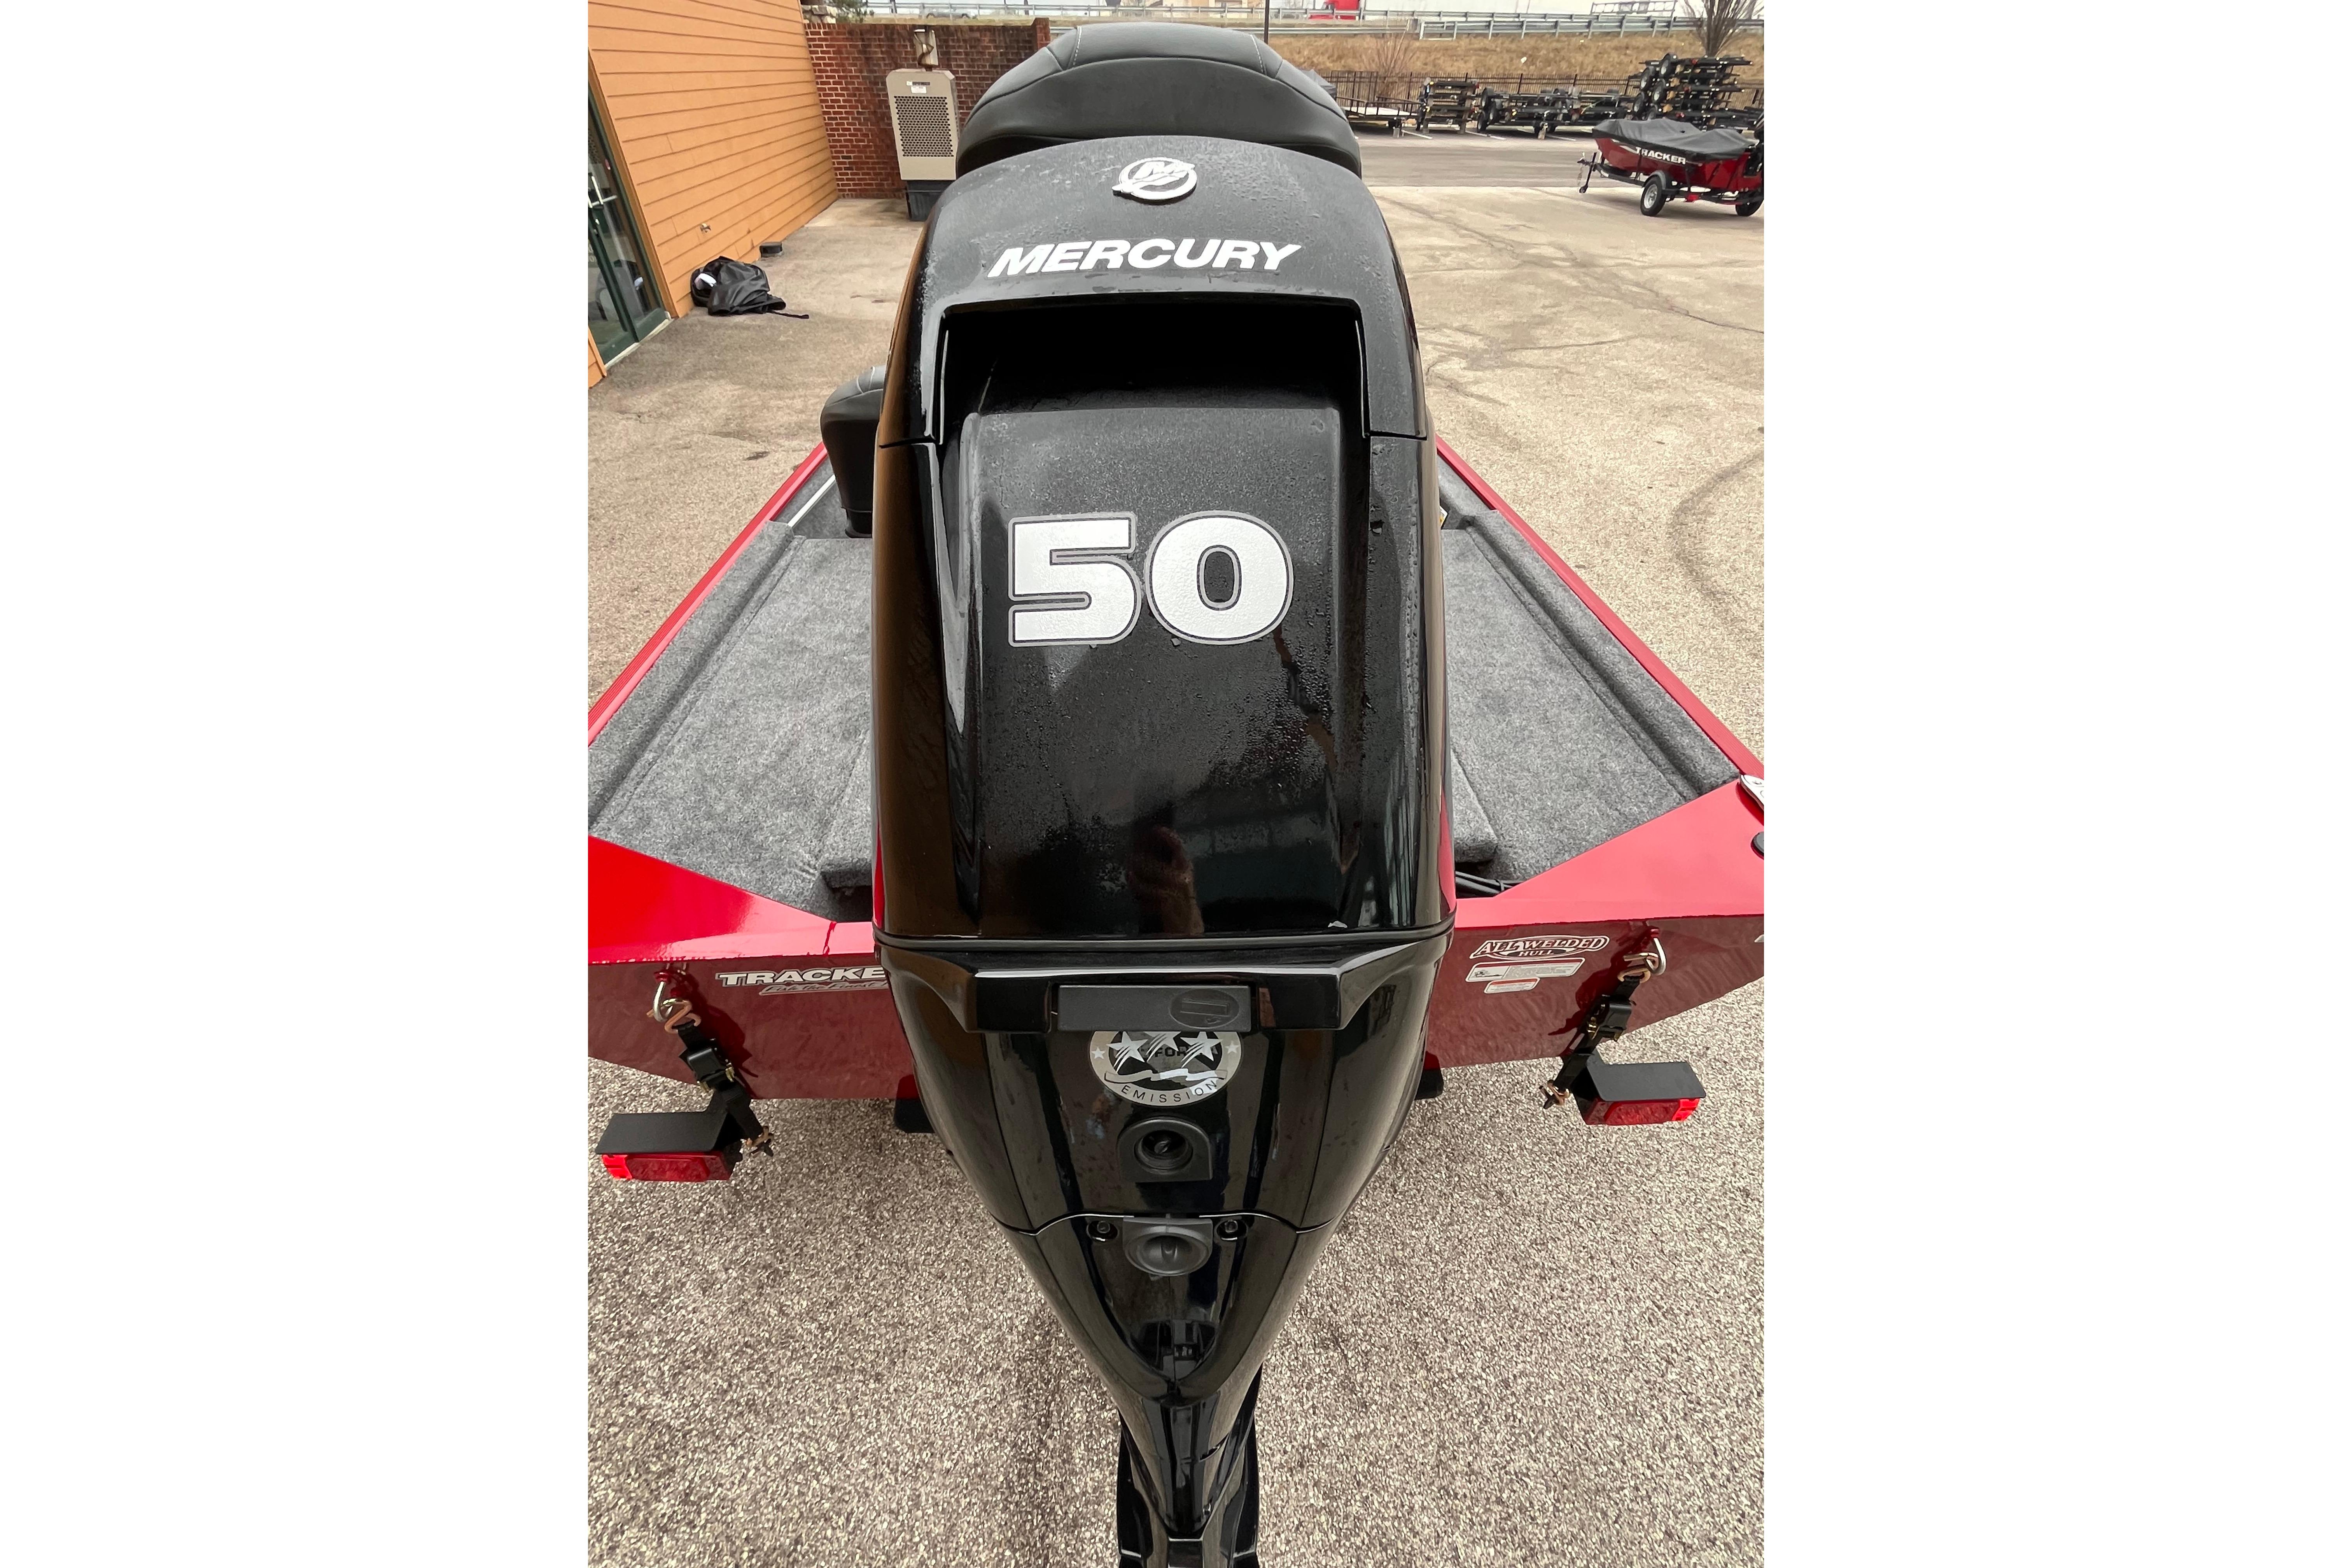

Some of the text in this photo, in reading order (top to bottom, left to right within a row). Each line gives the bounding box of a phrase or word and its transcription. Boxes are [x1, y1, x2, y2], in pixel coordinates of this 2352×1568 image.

[1636, 146, 1686, 164] TRACKER
[987, 238, 1302, 278] MERCURY
[1008, 510, 1294, 647] 50
[717, 966, 886, 986] TRACKE
[1121, 1080, 1217, 1103] EMISSION
